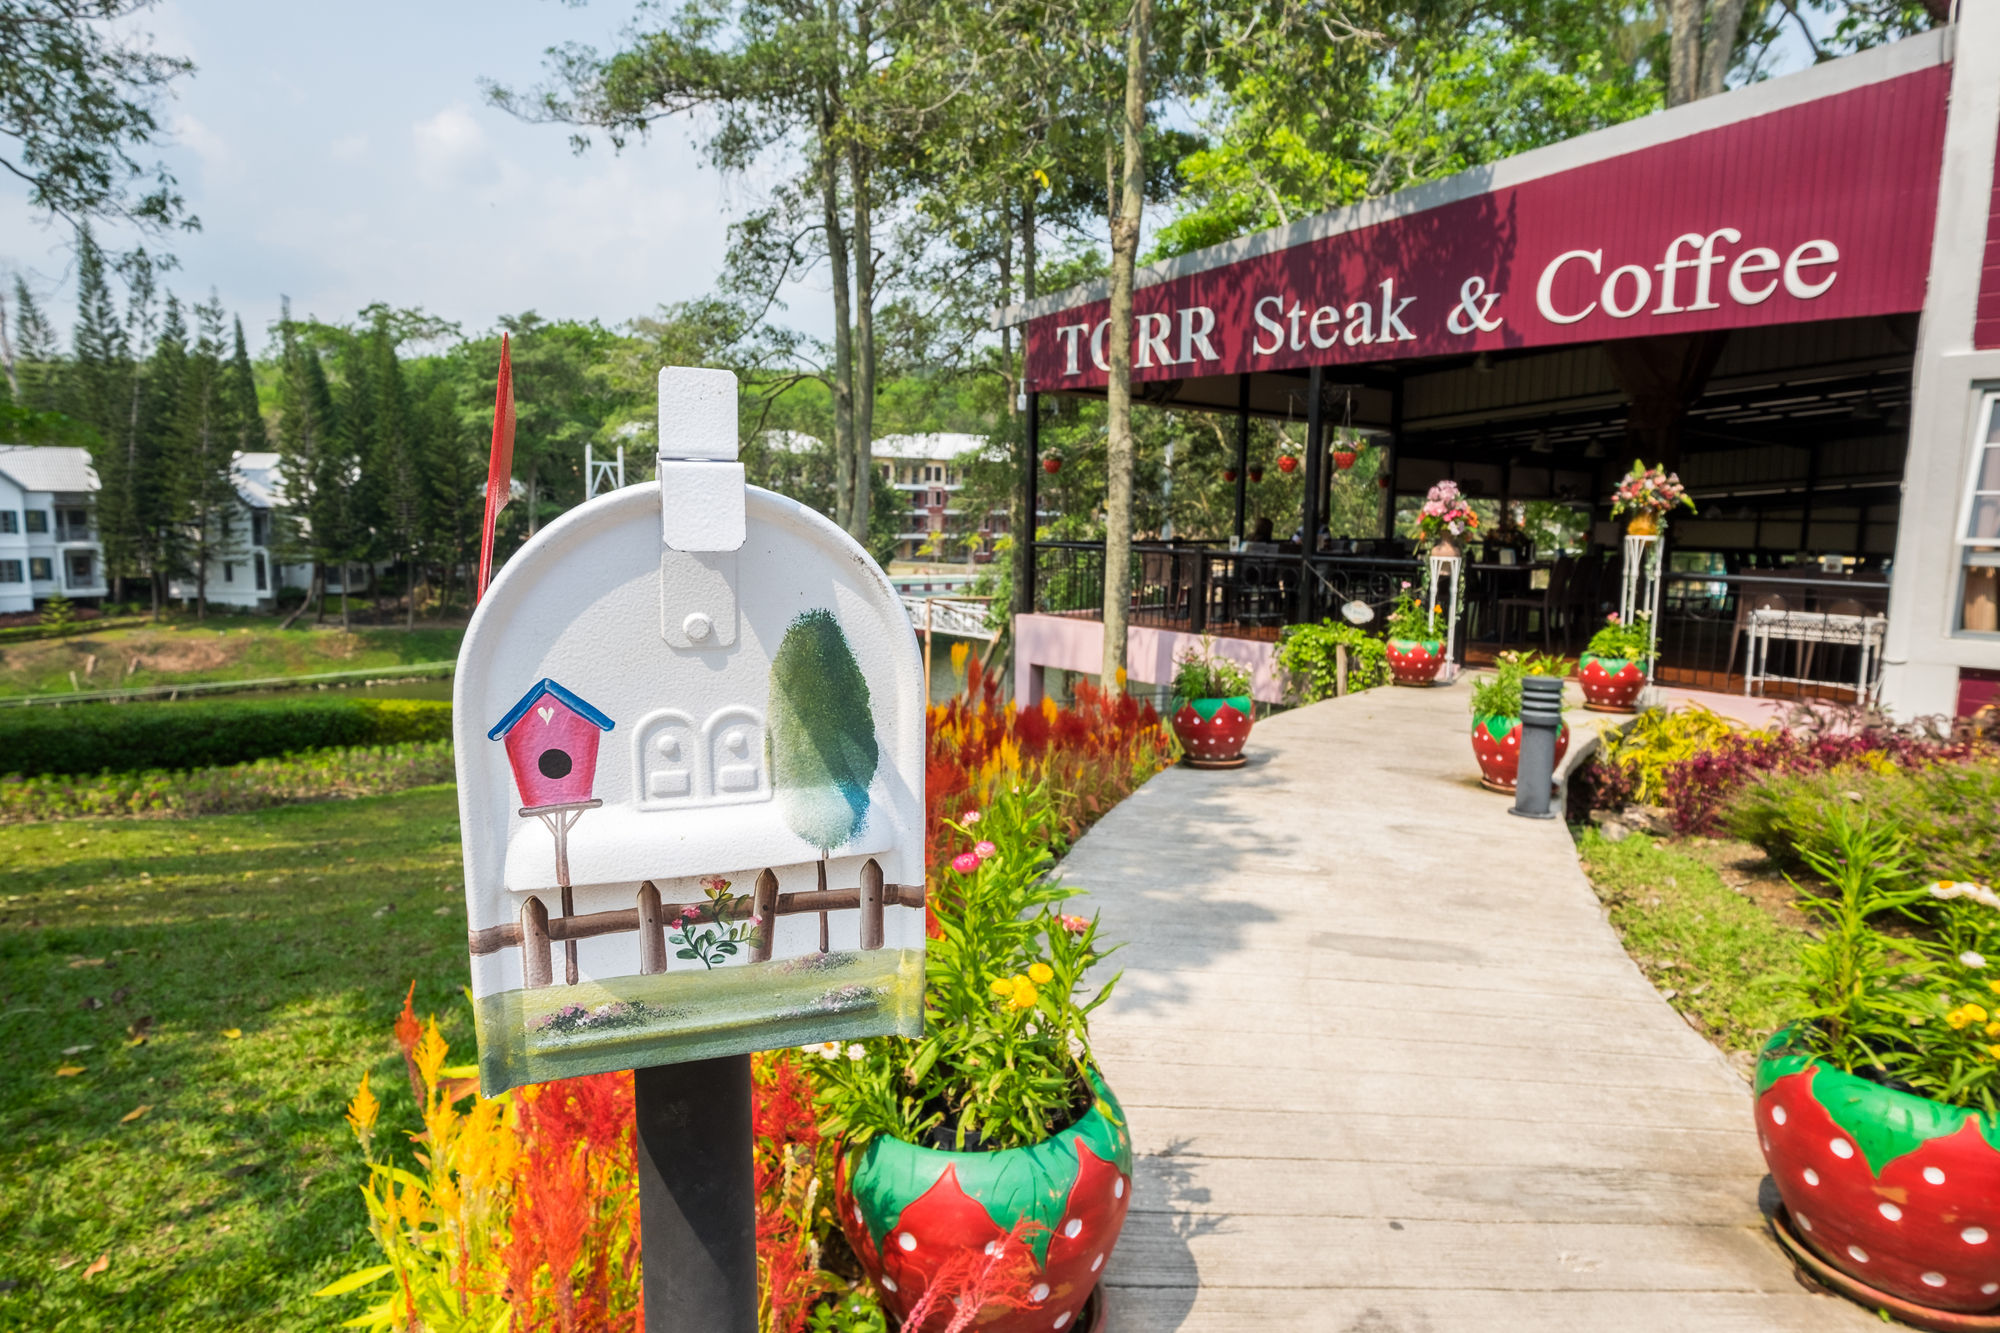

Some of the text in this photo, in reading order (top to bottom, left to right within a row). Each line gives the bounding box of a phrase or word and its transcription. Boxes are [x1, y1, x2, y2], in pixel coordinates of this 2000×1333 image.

[1252, 277, 1417, 356] Steak
[1447, 275, 1503, 335] &
[1536, 227, 1840, 325] Coffee
